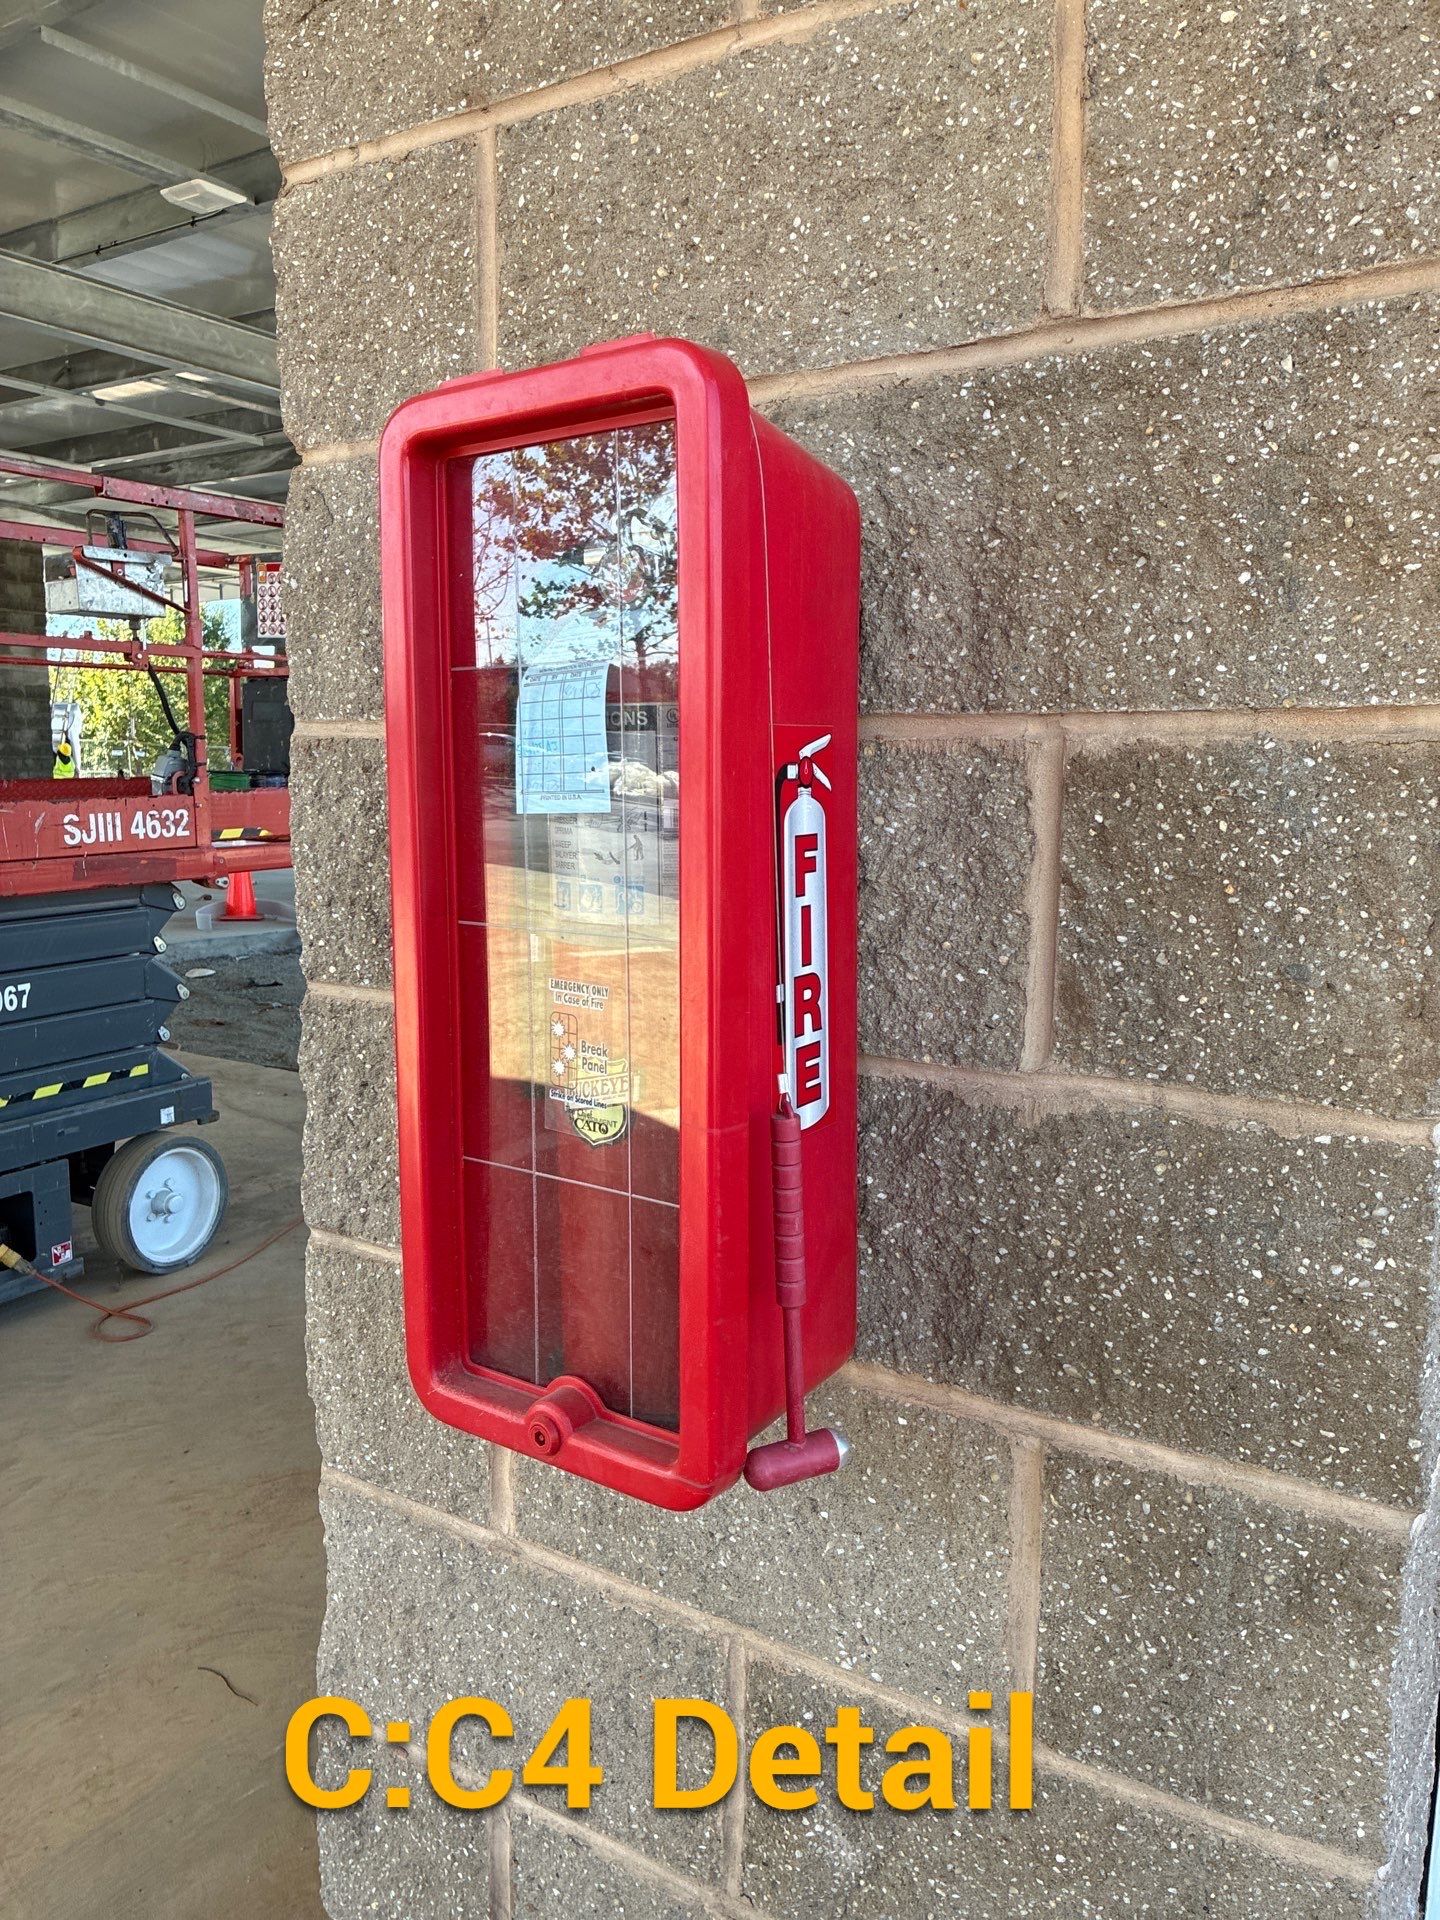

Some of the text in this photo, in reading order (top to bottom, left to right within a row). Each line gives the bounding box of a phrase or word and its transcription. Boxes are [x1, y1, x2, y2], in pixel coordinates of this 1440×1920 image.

[130, 808, 190, 839] 4632
[794, 834, 822, 1109] FIRE
[0, 982, 31, 1012] 67
[550, 979, 609, 998] EMERGENCY ONLY
[555, 992, 604, 1010] In Case of Fire
[581, 1040, 608, 1058] Break
[581, 1057, 608, 1075] Panel
[550, 1089, 565, 1100] Strike
[575, 1094, 593, 1107] Scored
[594, 1099, 607, 1109] Lines
[574, 1117, 609, 1135] CATO
